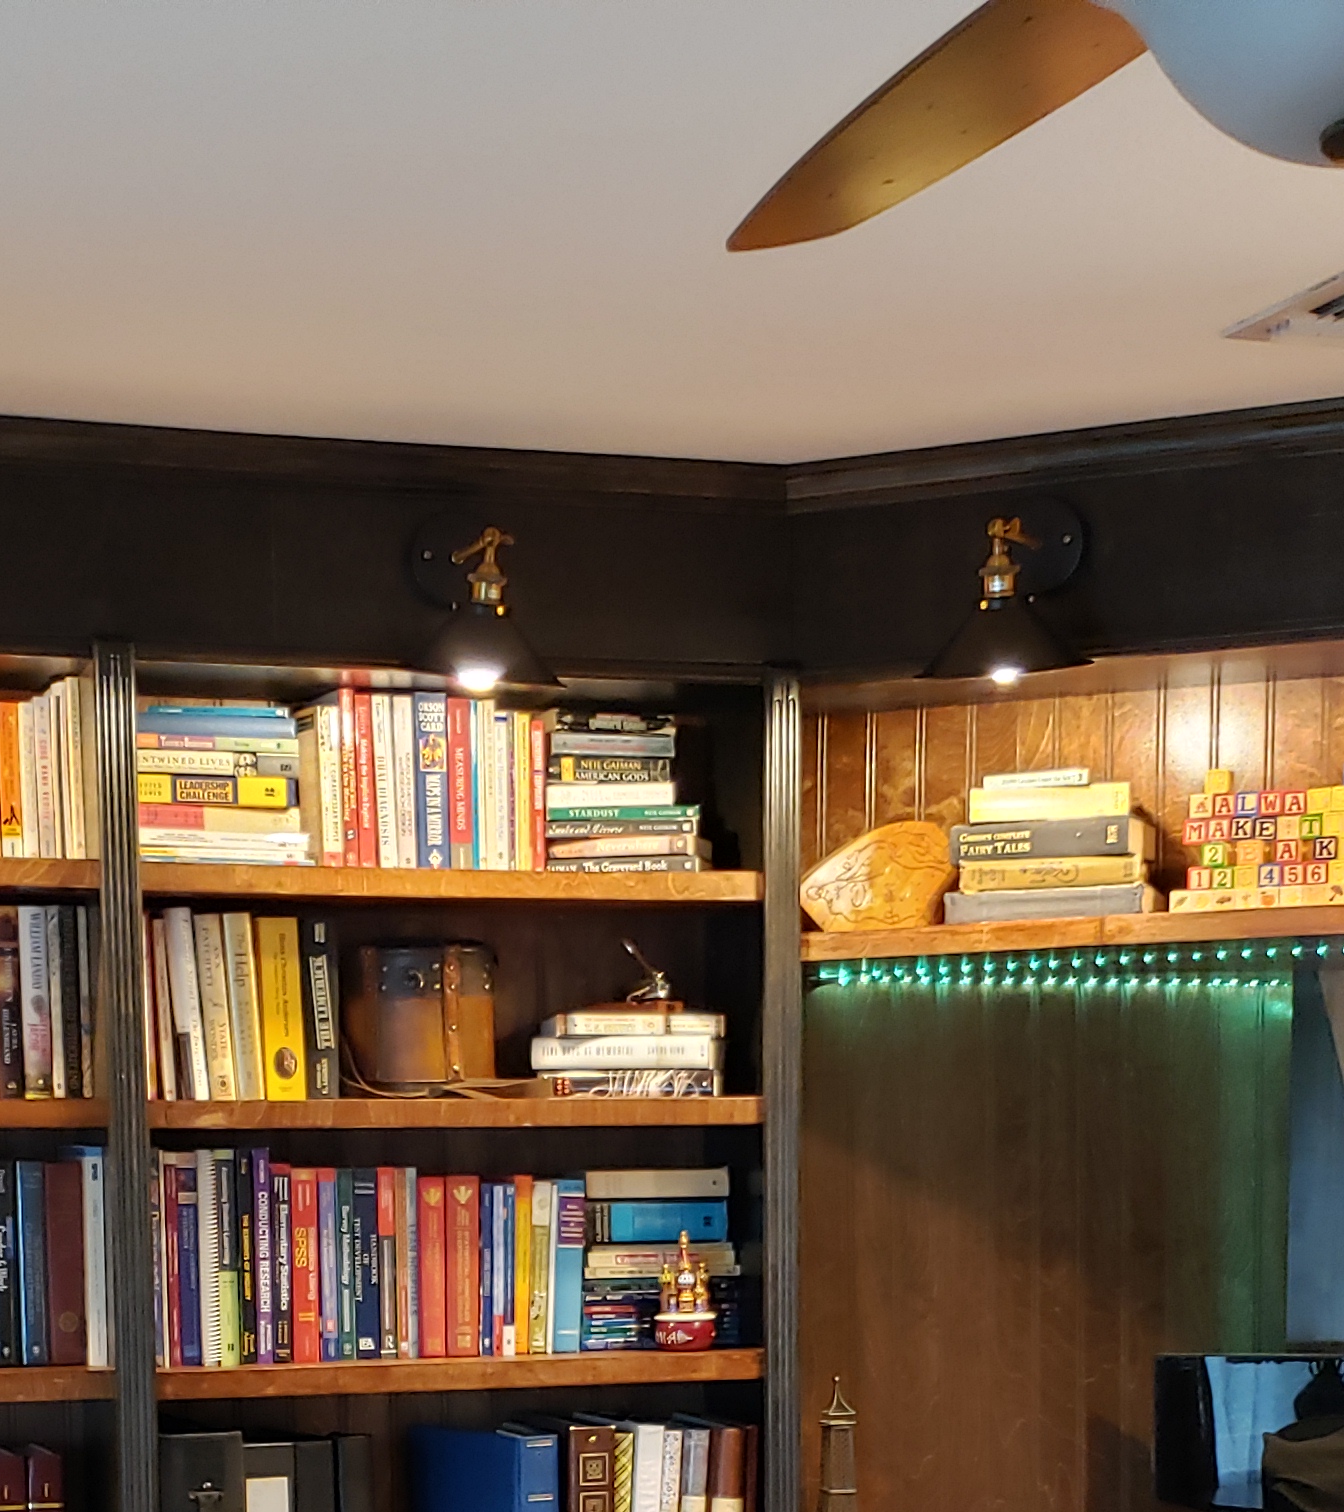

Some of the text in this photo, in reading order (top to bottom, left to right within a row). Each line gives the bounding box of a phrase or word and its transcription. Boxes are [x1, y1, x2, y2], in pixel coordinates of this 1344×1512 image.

[179, 780, 229, 790] LEADERSHIP
[180, 791, 230, 801] CHALLENGE
[569, 809, 619, 817] STARDUST
[29, 913, 42, 954] WILLIAM
[233, 952, 248, 987] Help
[257, 1191, 270, 1312] CONDUCTING RESEARCH
[294, 1227, 307, 1268] SPSS
